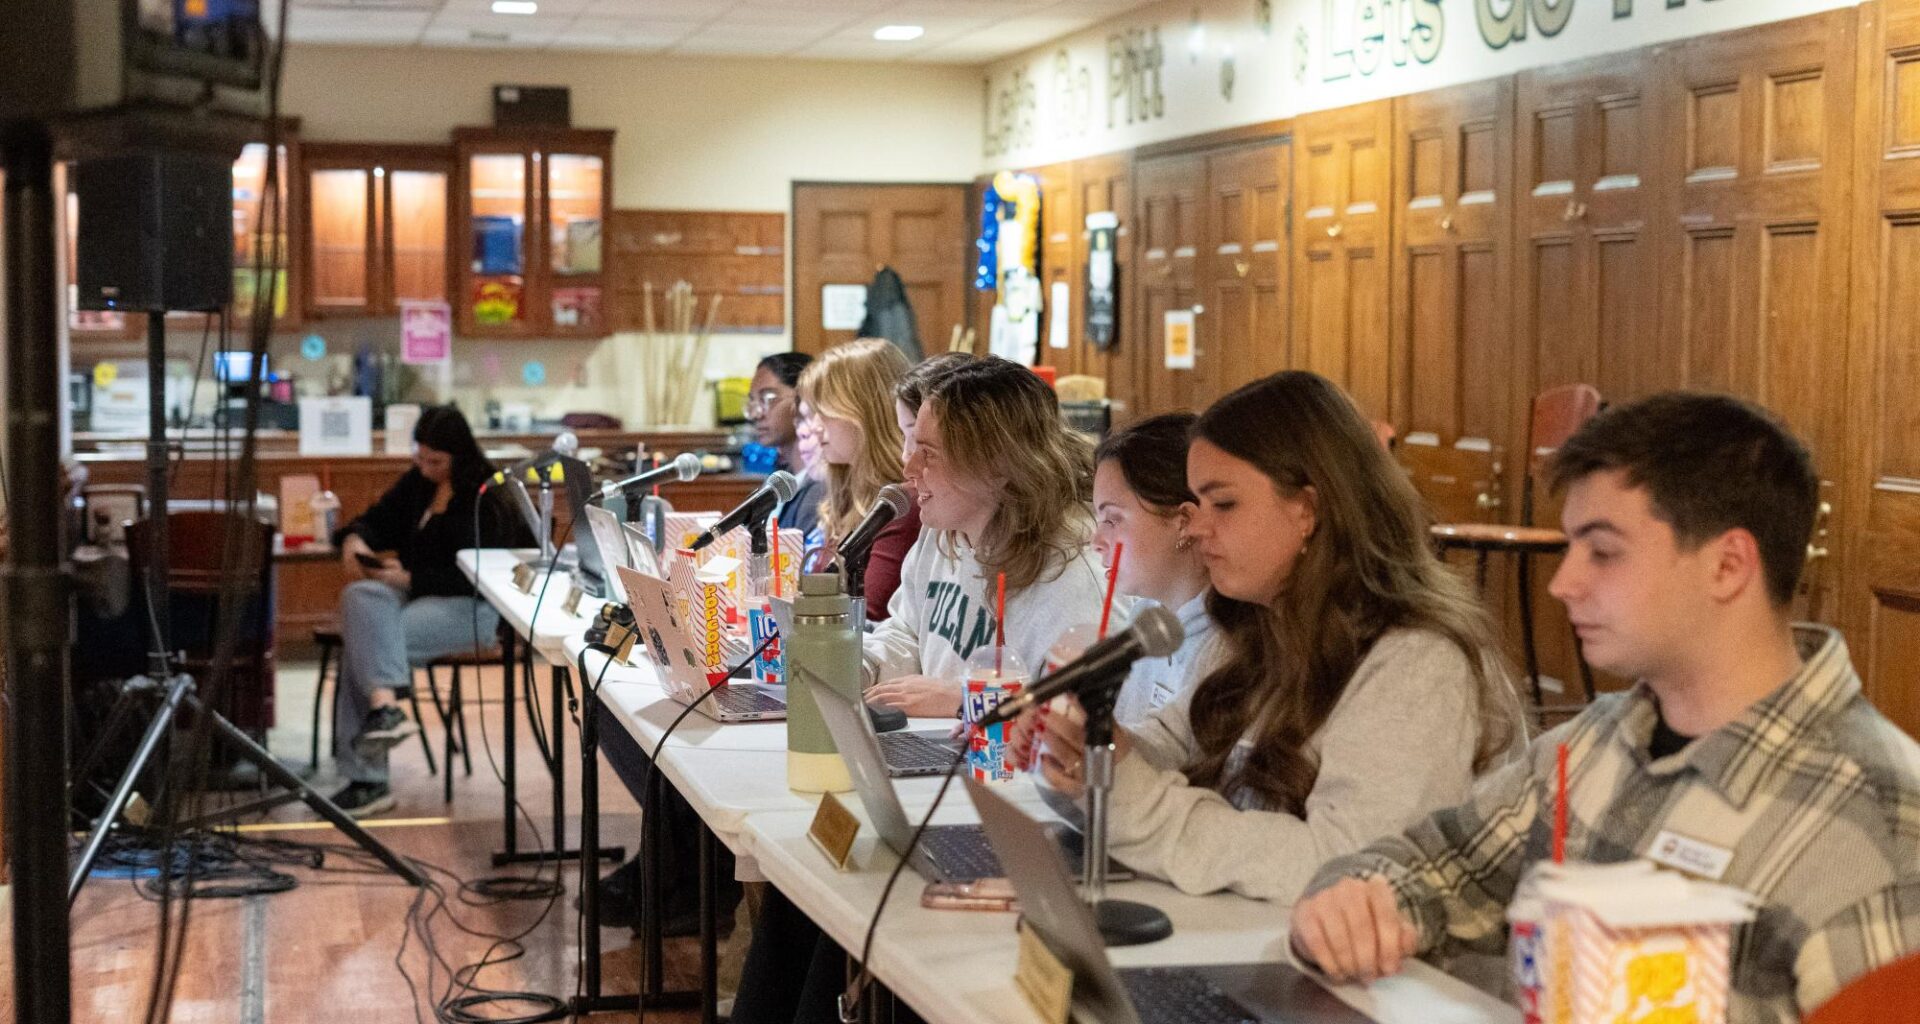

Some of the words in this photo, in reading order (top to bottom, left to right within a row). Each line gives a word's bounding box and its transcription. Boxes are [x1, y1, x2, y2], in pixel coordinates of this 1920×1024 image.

[1106, 24, 1164, 129] Pitt
[703, 583, 721, 668] POPCORN
[926, 581, 1005, 661] TULAN
